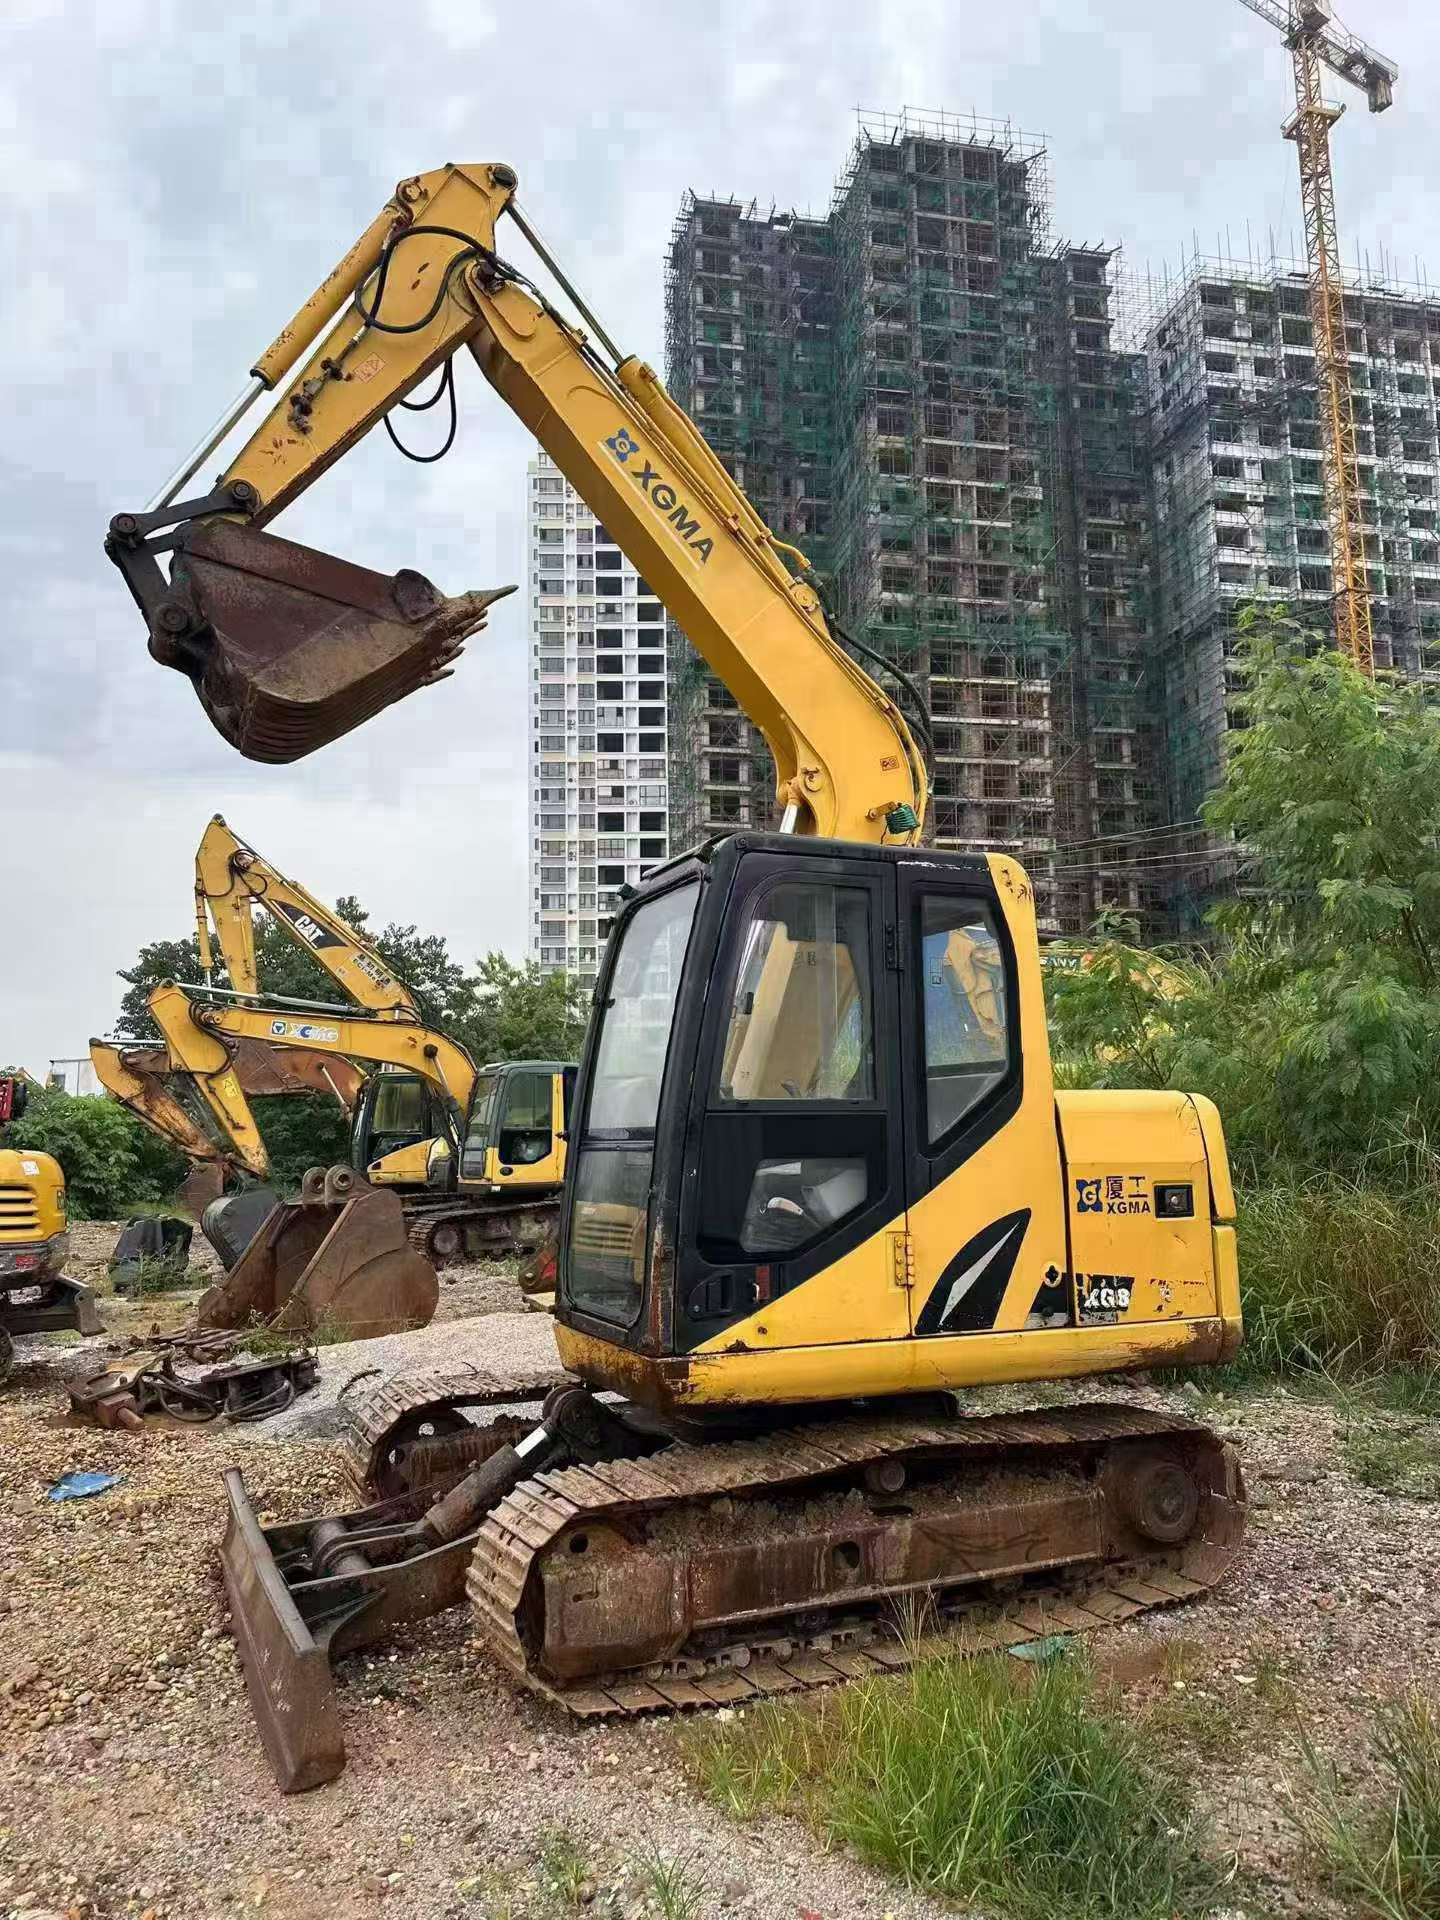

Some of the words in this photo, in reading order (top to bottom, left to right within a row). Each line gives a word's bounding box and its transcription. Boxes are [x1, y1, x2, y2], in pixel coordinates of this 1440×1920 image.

[631, 459, 714, 564] XGMA
[294, 915, 325, 943] CAT
[1106, 1175, 1148, 1199] 厦工
[1107, 1201, 1150, 1214] XGMA
